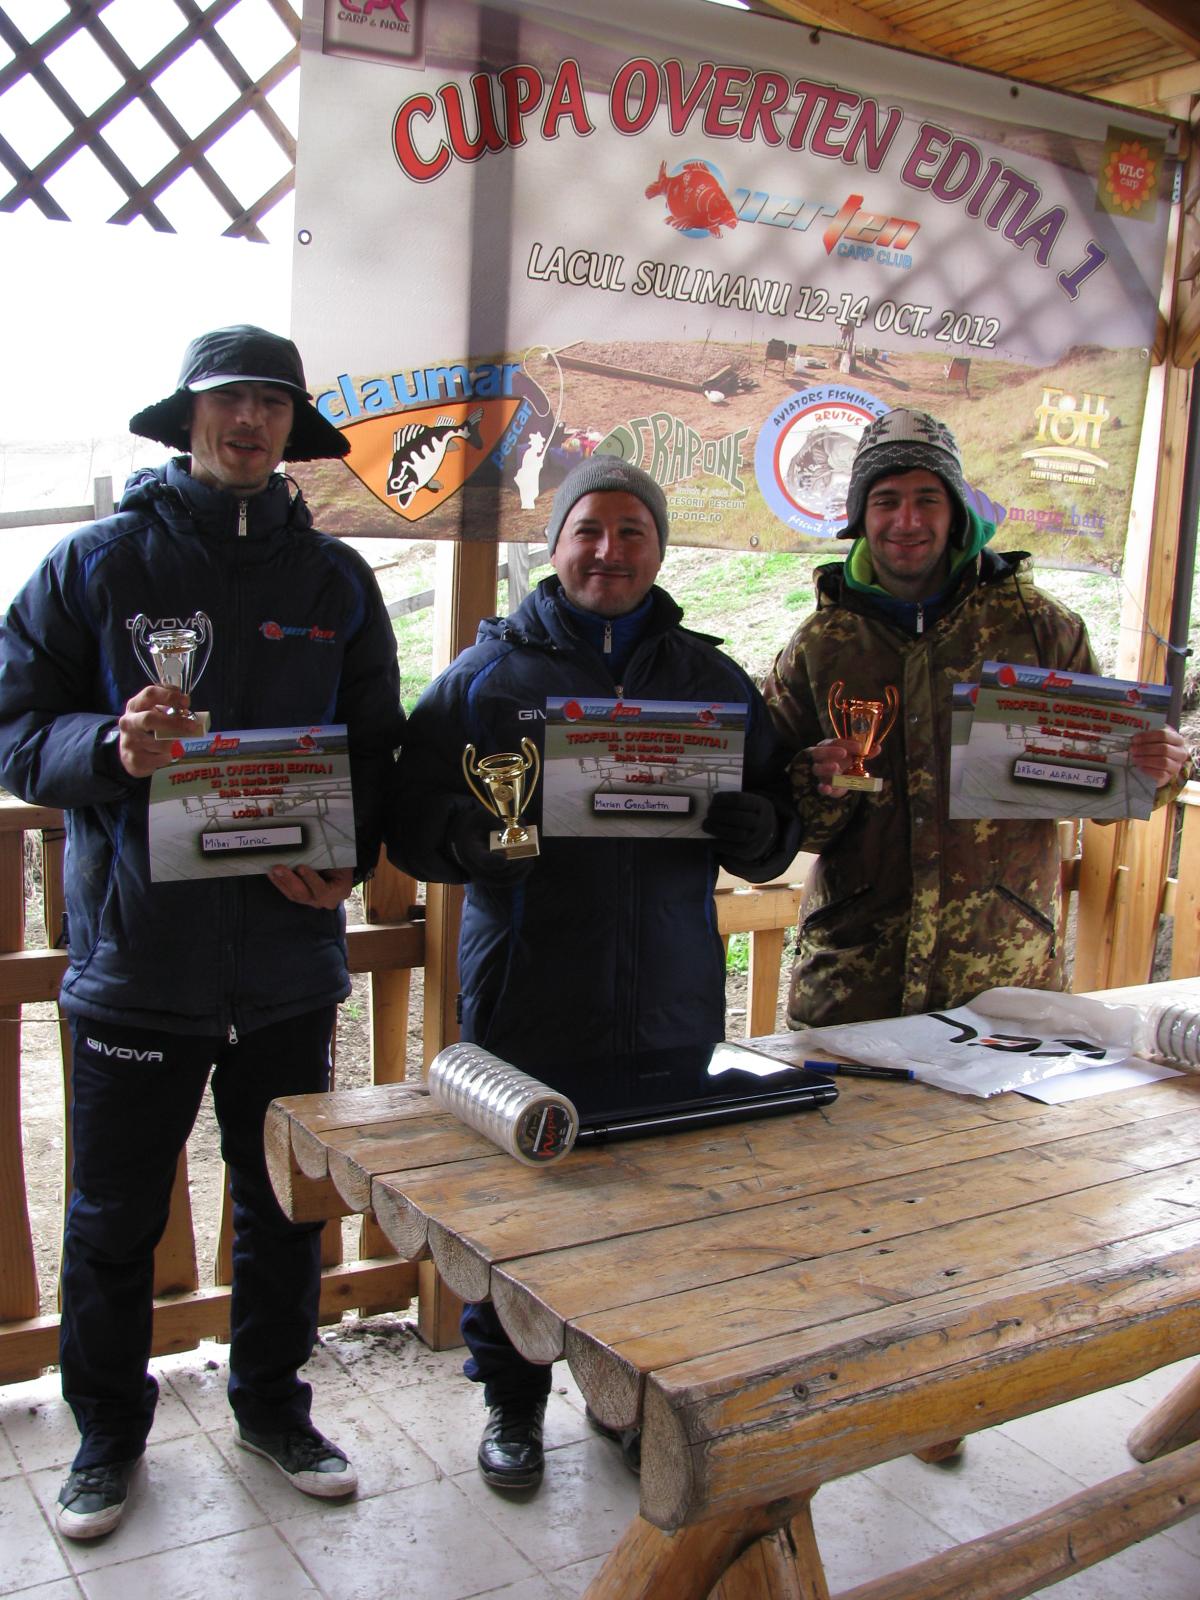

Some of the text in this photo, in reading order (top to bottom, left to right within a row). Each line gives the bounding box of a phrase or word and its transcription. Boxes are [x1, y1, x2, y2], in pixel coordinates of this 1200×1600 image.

[337, 11, 368, 25] CARP
[392, 58, 597, 184] CUPA
[609, 57, 904, 173] OVERTEN
[900, 121, 1068, 268] EDITIA
[1119, 162, 1145, 180] WLC
[837, 242, 913, 269] CARP CLUB
[526, 243, 1001, 349] LACUL SULIMANU 12-14 OCT. 2012
[316, 361, 523, 426] claumar
[773, 389, 874, 427] AVIATORS FISHING
[814, 410, 864, 426] BRUTUS
[491, 399, 533, 472] pescar
[709, 498, 746, 510] PESCUIT
[169, 766, 225, 786] TROFEUL
[226, 762, 284, 777] OVERTEN
[87, 1037, 163, 1063] GIVOVA
